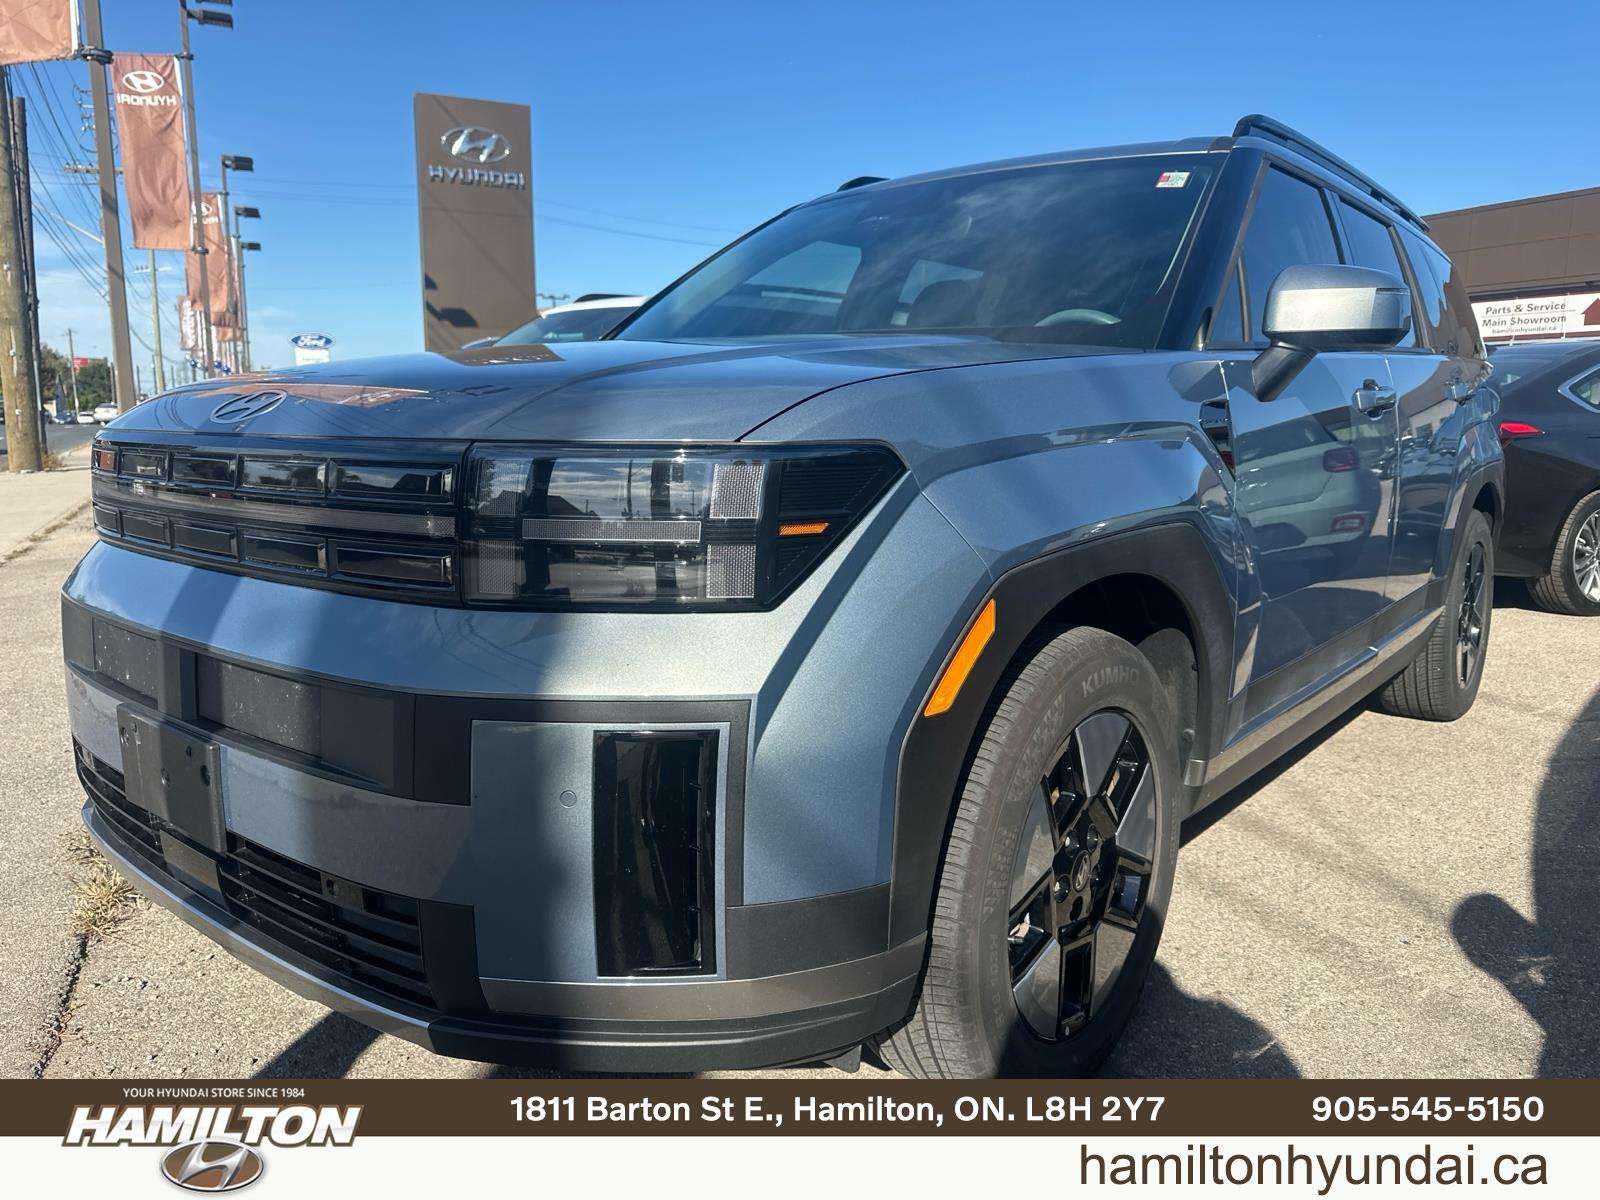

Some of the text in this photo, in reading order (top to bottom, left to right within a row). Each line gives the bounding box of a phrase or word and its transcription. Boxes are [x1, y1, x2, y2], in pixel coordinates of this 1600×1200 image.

[428, 165, 526, 188] HYUNDAI
[1485, 302, 1566, 315] Parts & Service
[1482, 315, 1567, 328] Main Showroom
